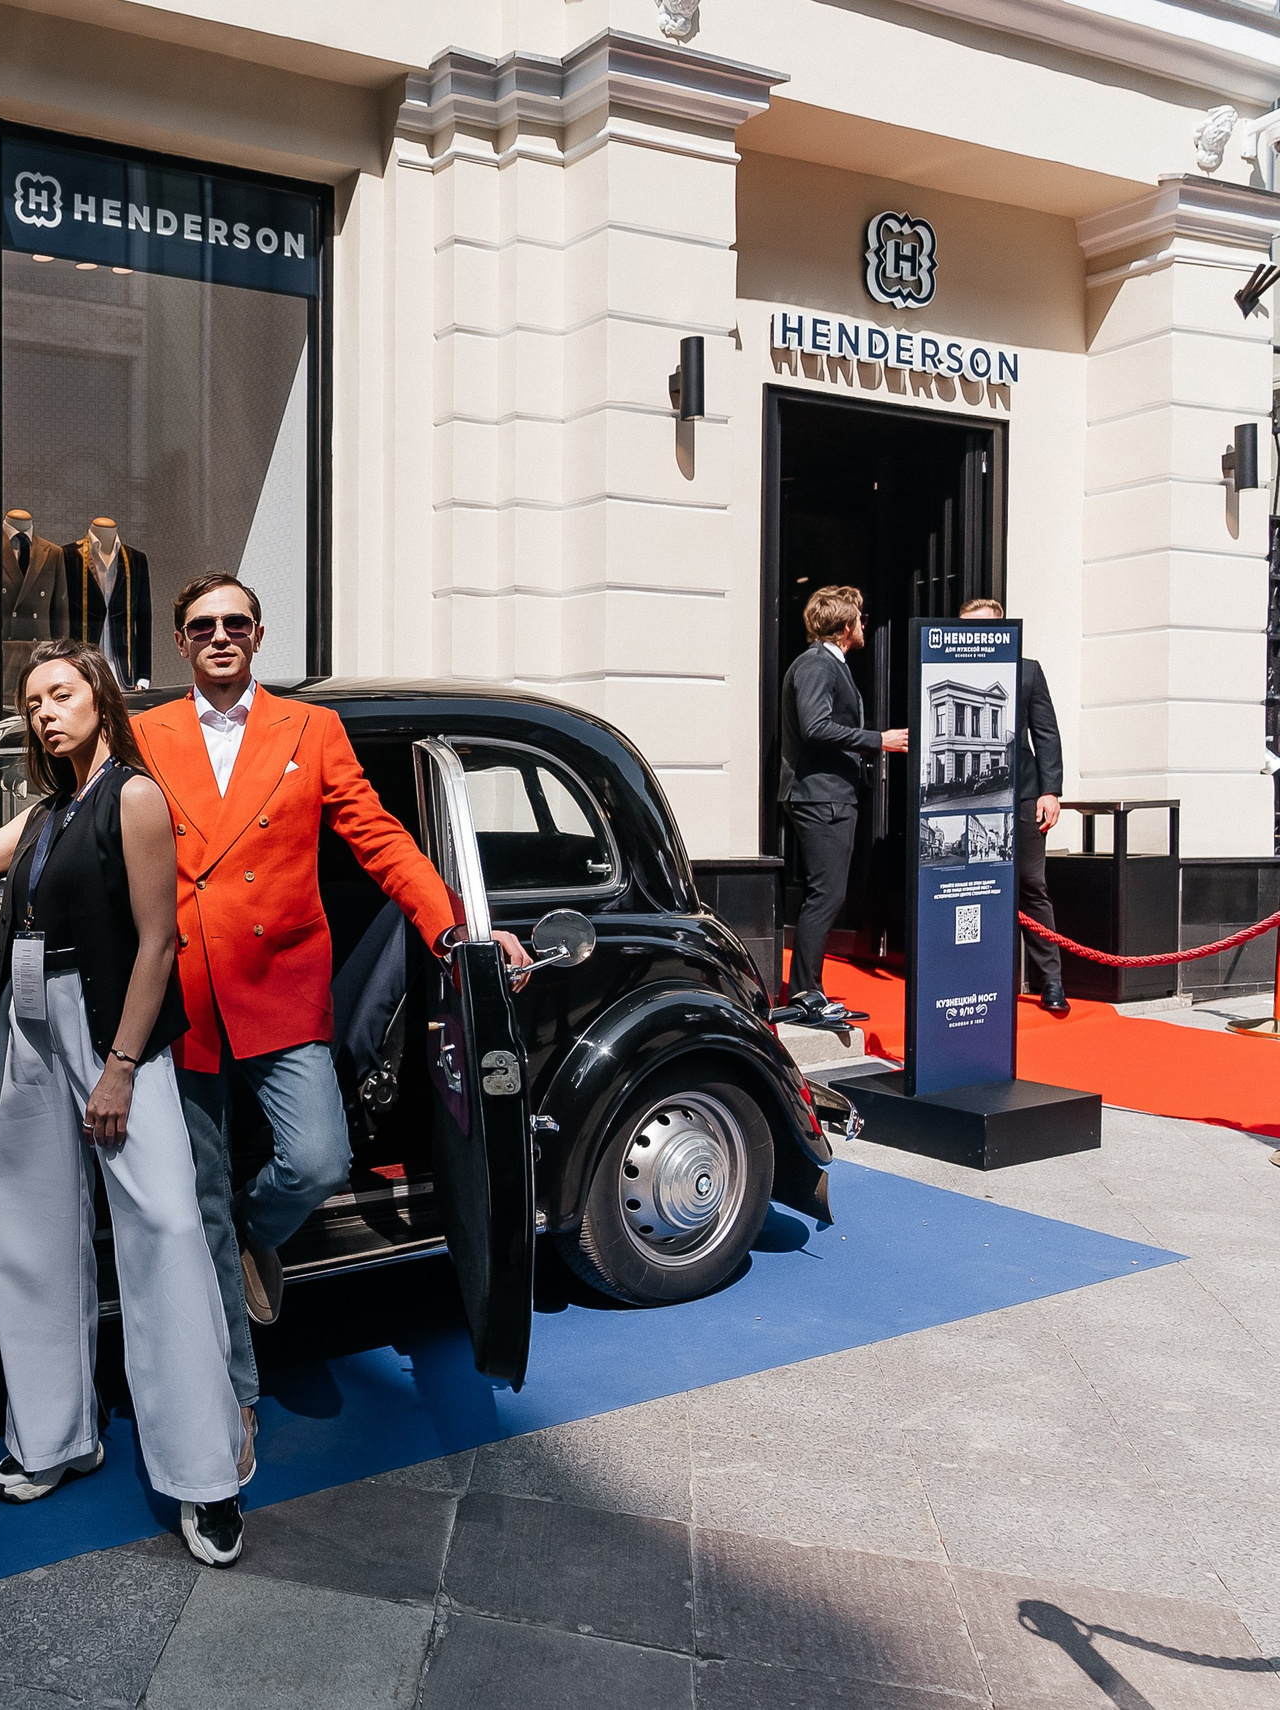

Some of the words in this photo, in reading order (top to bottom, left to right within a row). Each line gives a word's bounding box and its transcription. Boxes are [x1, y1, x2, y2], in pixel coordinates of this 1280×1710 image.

[73, 193, 305, 260] HENDERSON
[774, 311, 1019, 385] HENDERSON
[943, 632, 1011, 645] HENDERSON
[936, 994, 977, 1008] КУЗНЕЦКИЙ
[977, 992, 998, 1004] МОСТ
